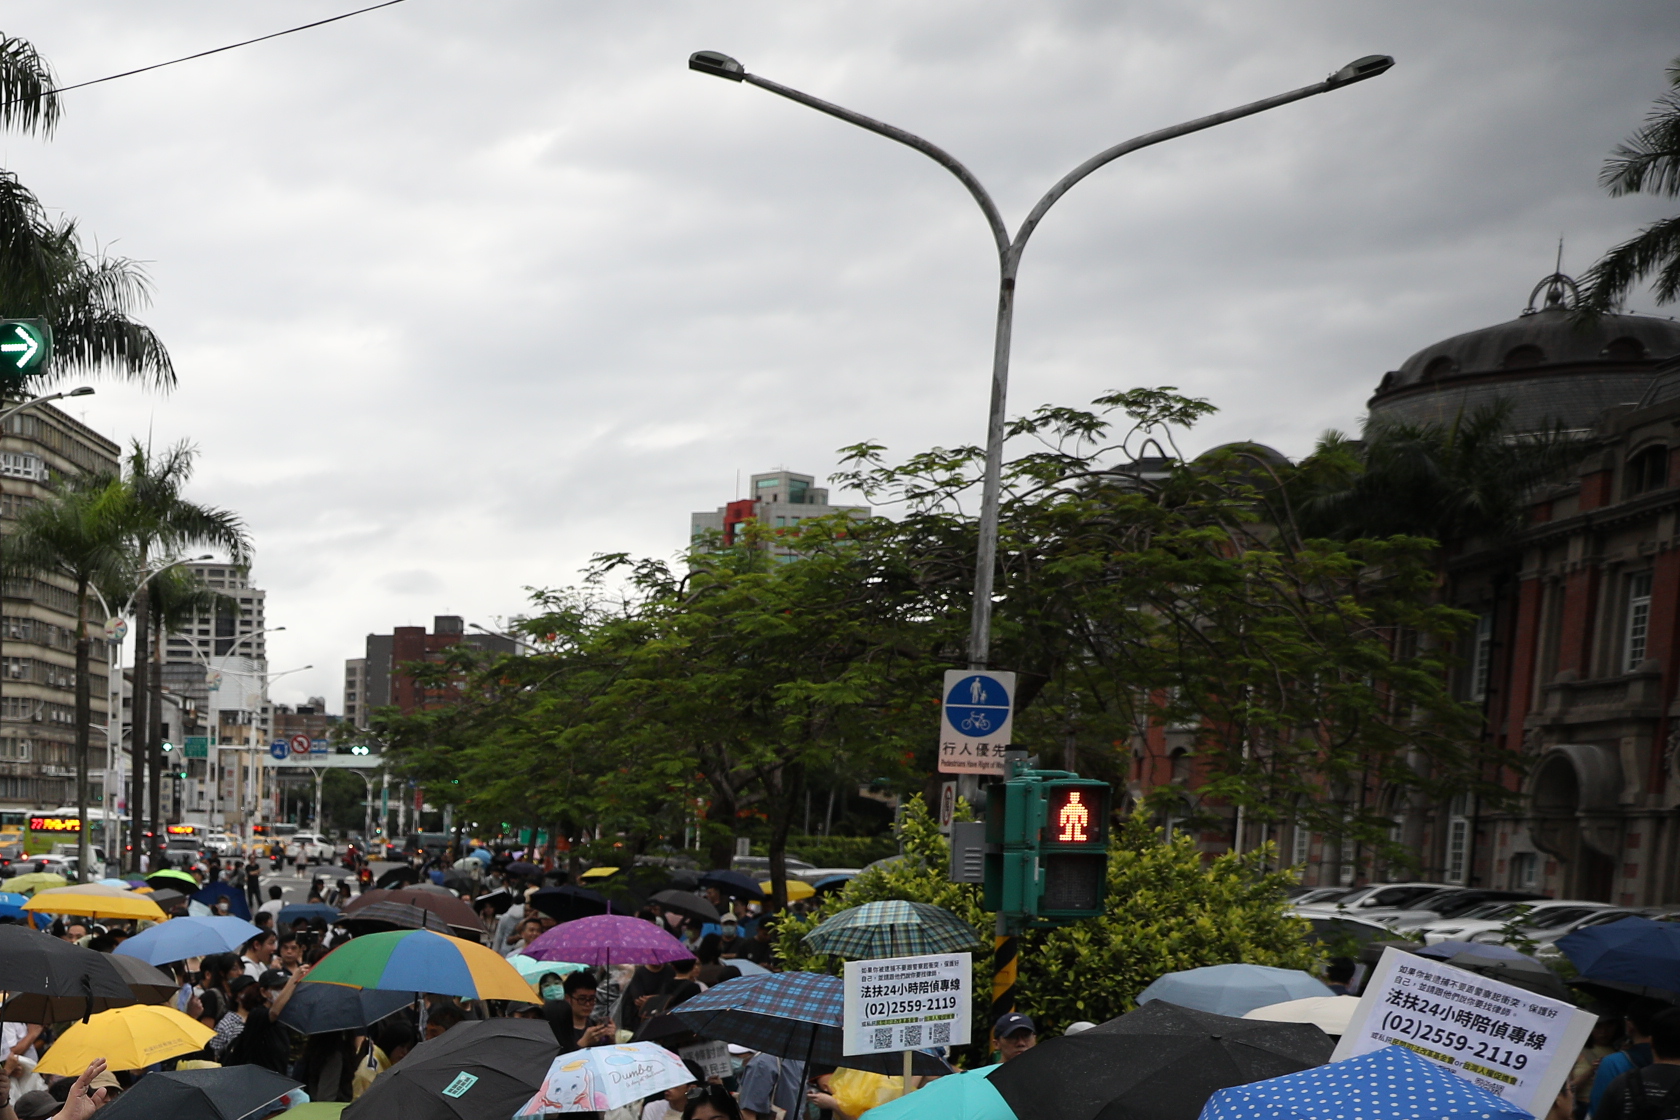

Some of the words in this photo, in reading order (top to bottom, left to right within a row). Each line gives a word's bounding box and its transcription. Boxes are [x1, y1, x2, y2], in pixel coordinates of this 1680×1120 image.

[942, 741, 1006, 757] 行人優先
[860, 978, 961, 999] 法扶24小時陪偵專線
[865, 996, 957, 1018] (02)2559-2119
[1384, 987, 1548, 1051] 法扶24小時陪偵專線
[1381, 1010, 1528, 1071] (02)2559-2119
[609, 1064, 654, 1084] Dumbo
